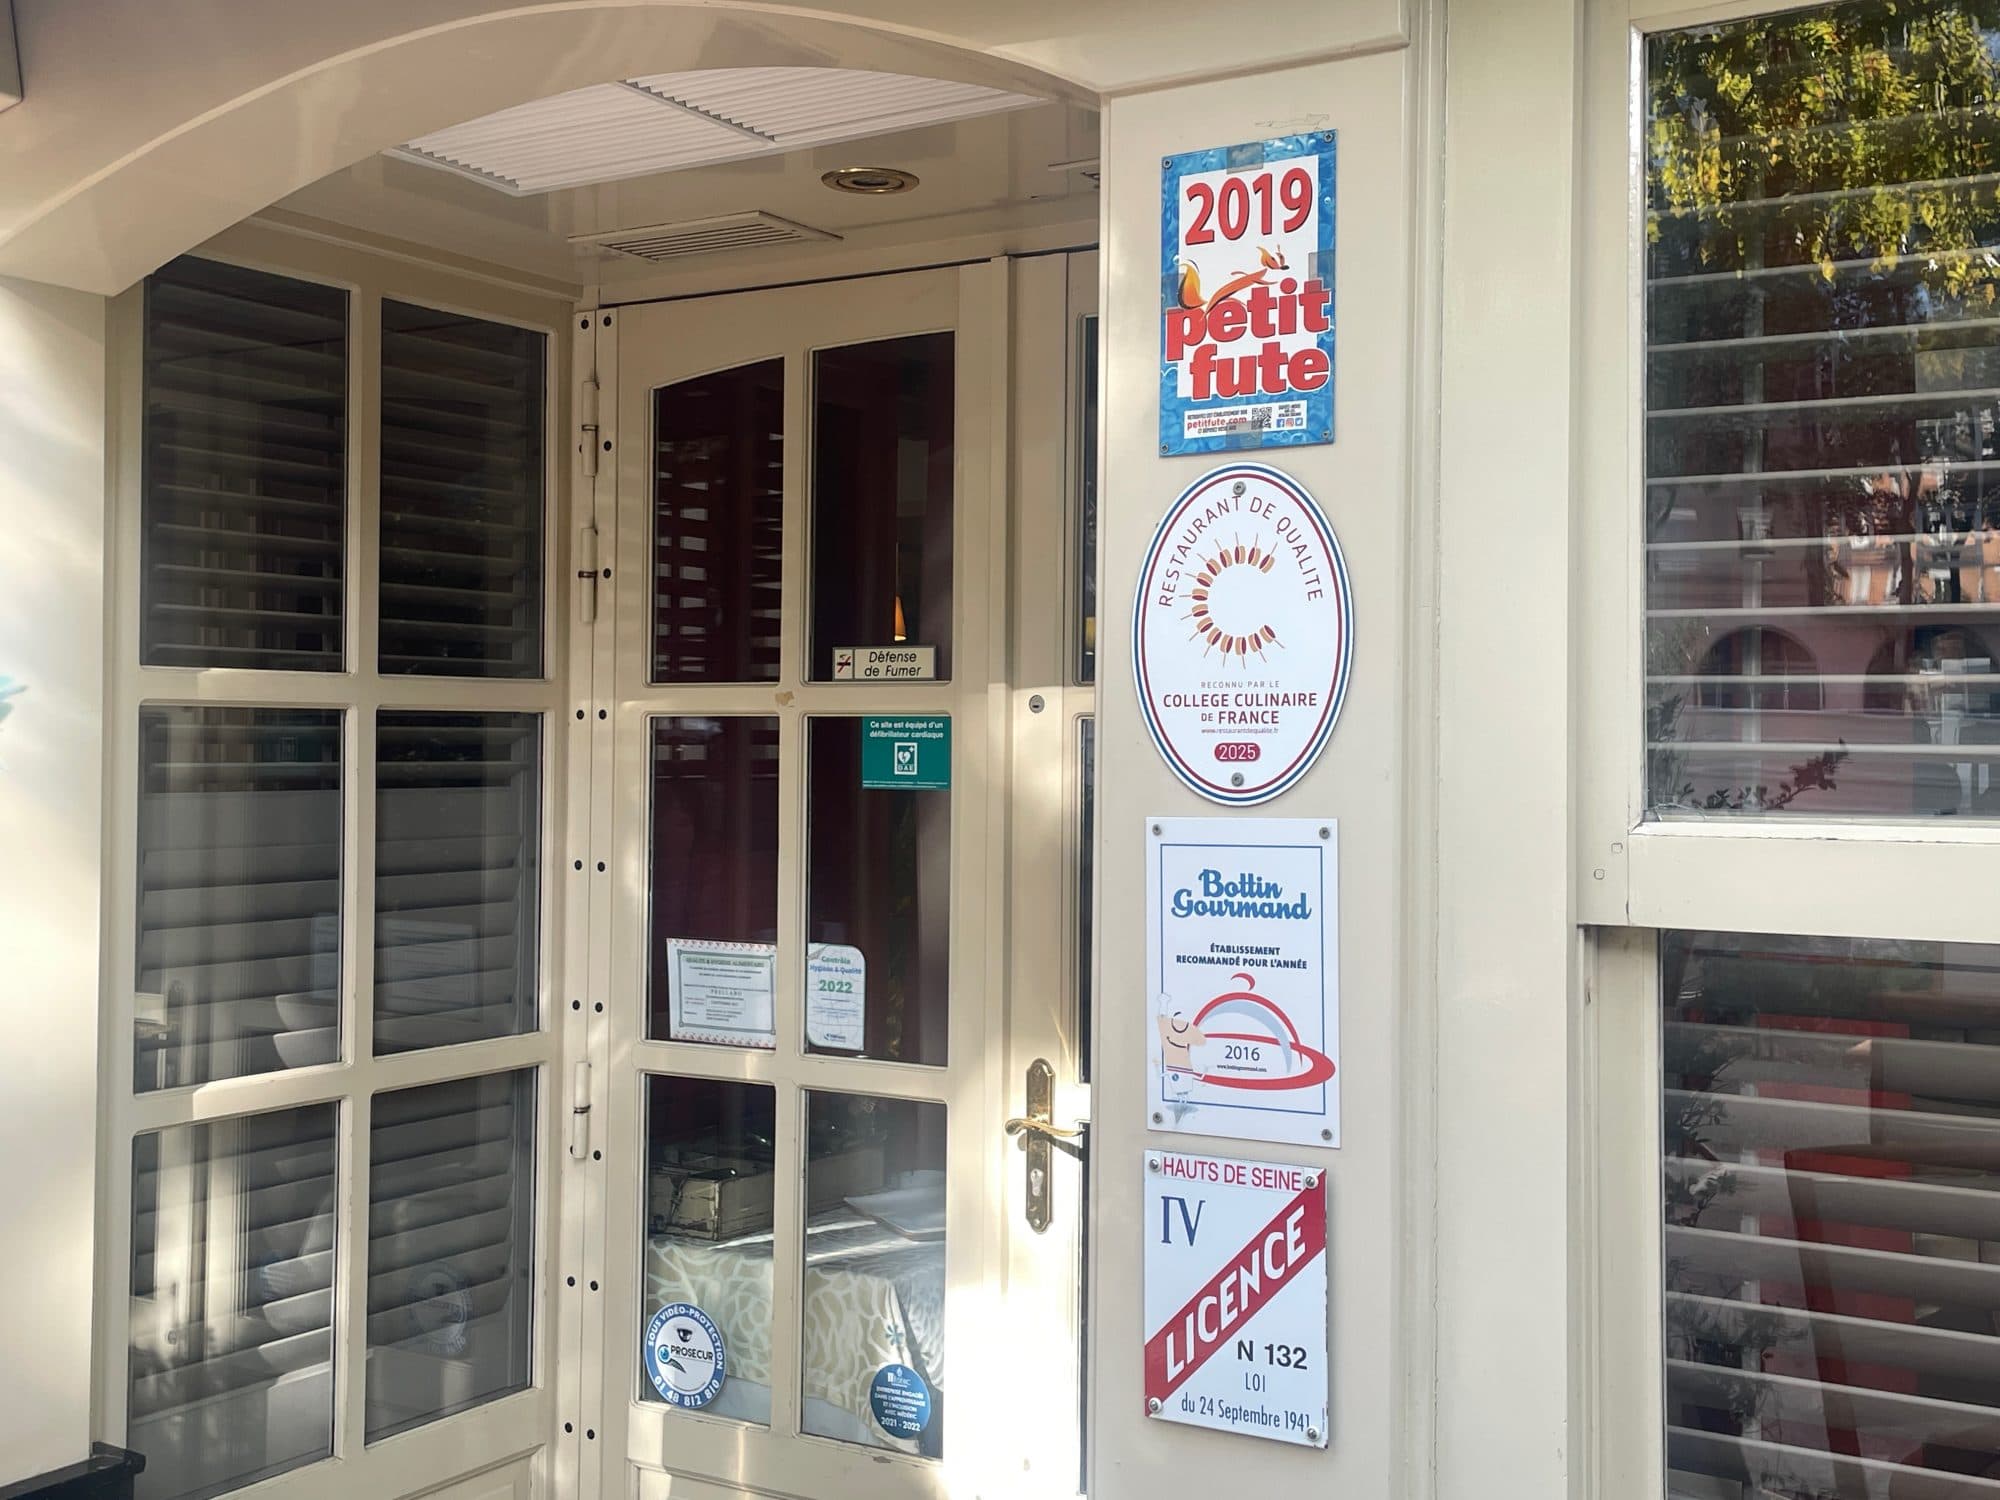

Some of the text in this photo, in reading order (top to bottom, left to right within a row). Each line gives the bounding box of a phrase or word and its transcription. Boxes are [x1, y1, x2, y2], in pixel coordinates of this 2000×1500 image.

[1184, 167, 1313, 245] 2019
[1165, 277, 1331, 363] petit
[1187, 416, 1247, 430] petitfute.com
[1158, 495, 1324, 607] RESTAURANT DE QUALITE
[869, 651, 917, 663] Défense
[864, 665, 921, 677] de Fumer
[1201, 680, 1280, 689] RECONNU PAR LE
[1163, 692, 1318, 708] COLLEGE CULINAIRE
[1201, 710, 1280, 725] DE FRANCE
[1218, 744, 1257, 760] 2025
[1198, 868, 1283, 899] Bottin
[1171, 888, 1312, 920] Gourmand
[1210, 942, 1280, 956] ÉTABLISSEMENT
[1176, 954, 1307, 969] RECOMMANDÉ POUR L'ANNÉE
[818, 979, 853, 993] 2022
[1224, 1044, 1261, 1062] 2016
[1162, 1156, 1302, 1191] HAUTS DE SEINE
[1160, 1195, 1206, 1247] IV
[1165, 1204, 1306, 1384] LICENCE
[670, 1344, 714, 1360] PROSECUR
[1237, 1339, 1308, 1370] N 132
[1245, 1372, 1266, 1393] LOI
[1181, 1391, 1195, 1413] du
[1199, 1395, 1214, 1416] 24
[1218, 1399, 1280, 1428] Septembre
[1284, 1410, 1310, 1432] 1941
[881, 1417, 897, 1427] 2021
[902, 1420, 921, 1432] 2022
